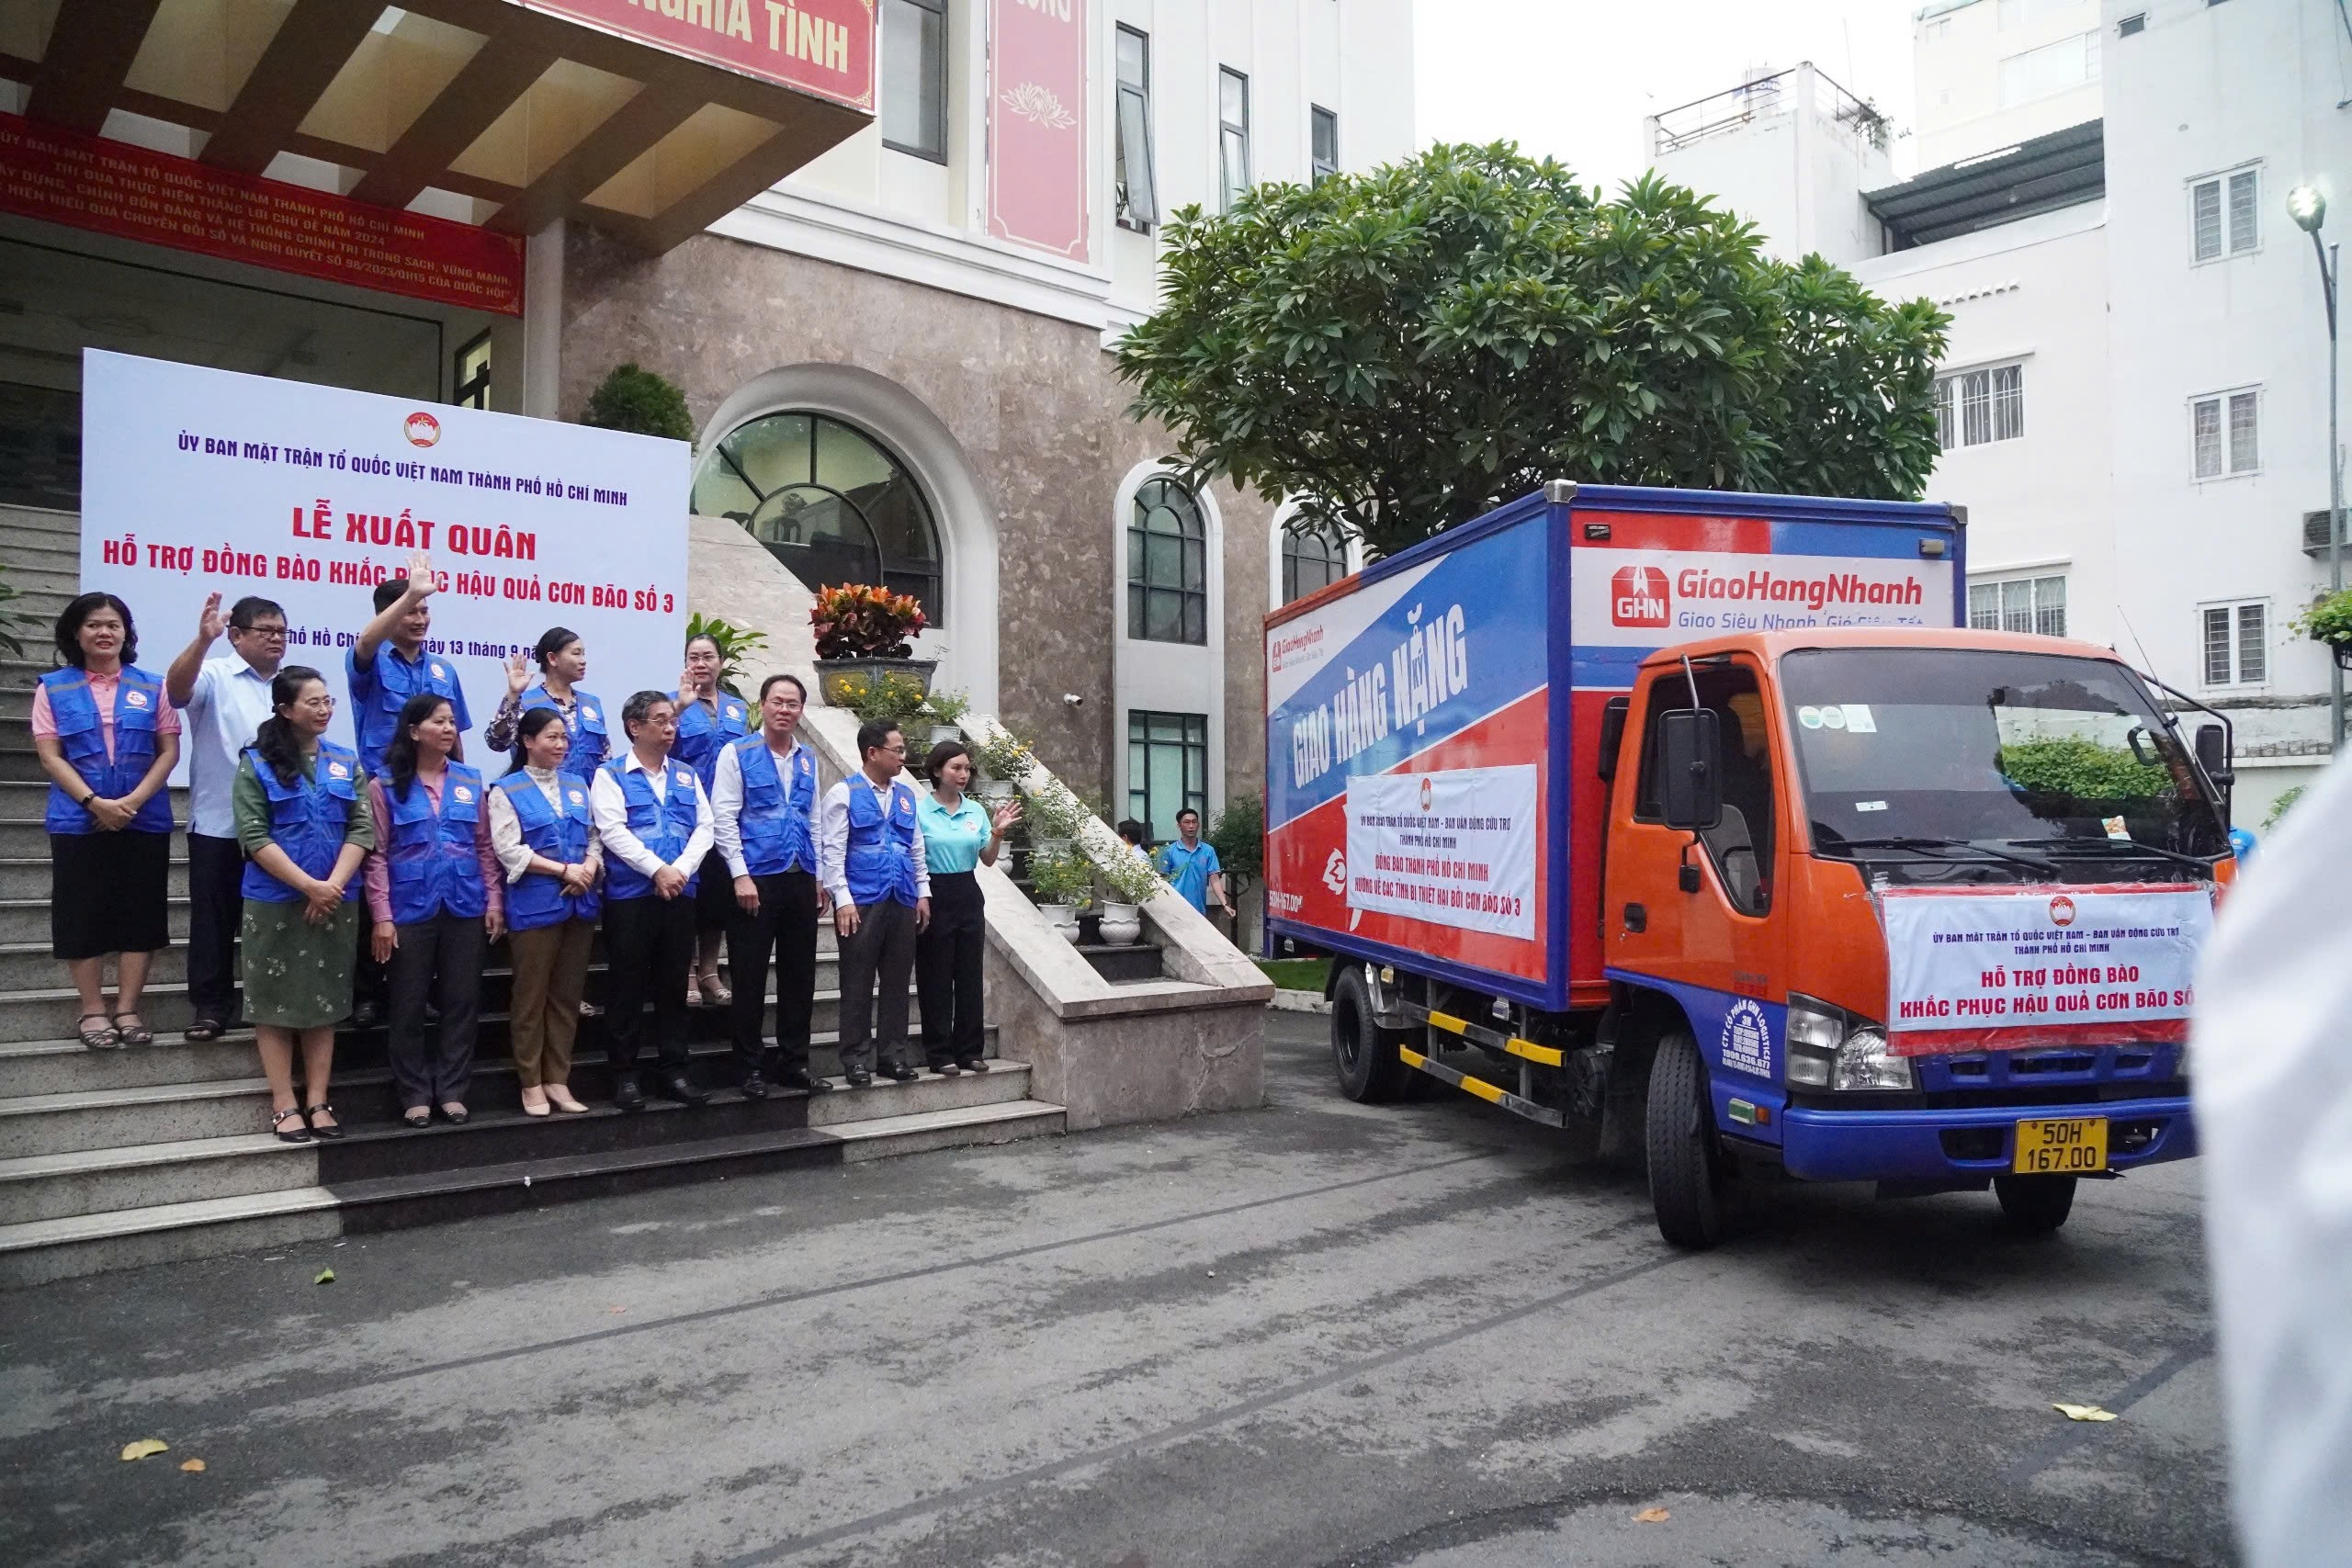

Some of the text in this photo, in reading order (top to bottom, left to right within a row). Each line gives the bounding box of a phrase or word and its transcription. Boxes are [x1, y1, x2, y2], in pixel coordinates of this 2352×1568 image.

[764, 0, 848, 73] TÌNH
[394, 225, 425, 240] MINH
[363, 247, 401, 265] TRONG
[178, 429, 628, 506] ỦY BAN MẶT TRẬN TỔ QUỐC VIỆT NAM THÀNH PHỐ HỒ CHÍ MINH
[292, 499, 537, 560] LỄ XUẤT QUÂN
[103, 533, 673, 614] HỖ TRỢ ĐỒNG BÀO KHẮC HẬU QUẢ CƠN BÃO SỐ 3
[1677, 569, 1923, 611] GiaoHangNhanh
[1616, 598, 1665, 620] GHN
[1678, 612, 1716, 629] Giao
[1721, 612, 1758, 630] Siêu
[312, 626, 331, 647] Hồ
[449, 640, 464, 656] 13
[468, 640, 505, 660] tháng
[1293, 602, 1468, 790] GIAO HÀNG NẶNG
[1426, 854, 1440, 877] PHỐ
[1442, 855, 1451, 878] HỒ
[1453, 859, 1465, 880] CHÍ
[1468, 863, 1488, 882] MINH
[1383, 878, 1394, 897] CÁC
[1410, 886, 1417, 904] BỊ
[1437, 888, 1448, 909] HẠI
[1465, 892, 1480, 911] CƠN
[1515, 897, 1521, 917] 3
[1946, 931, 1963, 942] BAN
[1984, 930, 2008, 943] TRẬN
[2010, 927, 2021, 942] TỔ
[2022, 928, 2044, 942] QUỐC
[2046, 930, 2064, 942] VIỆT
[2066, 931, 2084, 940] NAM
[2093, 930, 2109, 939] BAN
[2110, 928, 2126, 941] VẬN
[2128, 928, 2149, 941] ĐỘNG
[2014, 941, 2109, 955] THÀNH PHỐ HỒ CHÍ MINH
[1981, 964, 2139, 989] HỖ TRỢ ĐỒNG BÀO
[1900, 995, 1950, 1019] KHẮC
[1956, 998, 2006, 1019] PHỤC
[2013, 995, 2048, 1018] HẬU
[2055, 989, 2089, 1011] QUẢ
[2096, 992, 2129, 1010] CƠN
[2135, 988, 2168, 1008] BÃO
[1757, 1012, 1770, 1060] LOGISTICS
[1722, 1049, 1770, 1069] 1900.636.677
[2043, 1122, 2082, 1145] 50H
[2028, 1146, 2096, 1170] 167.00
